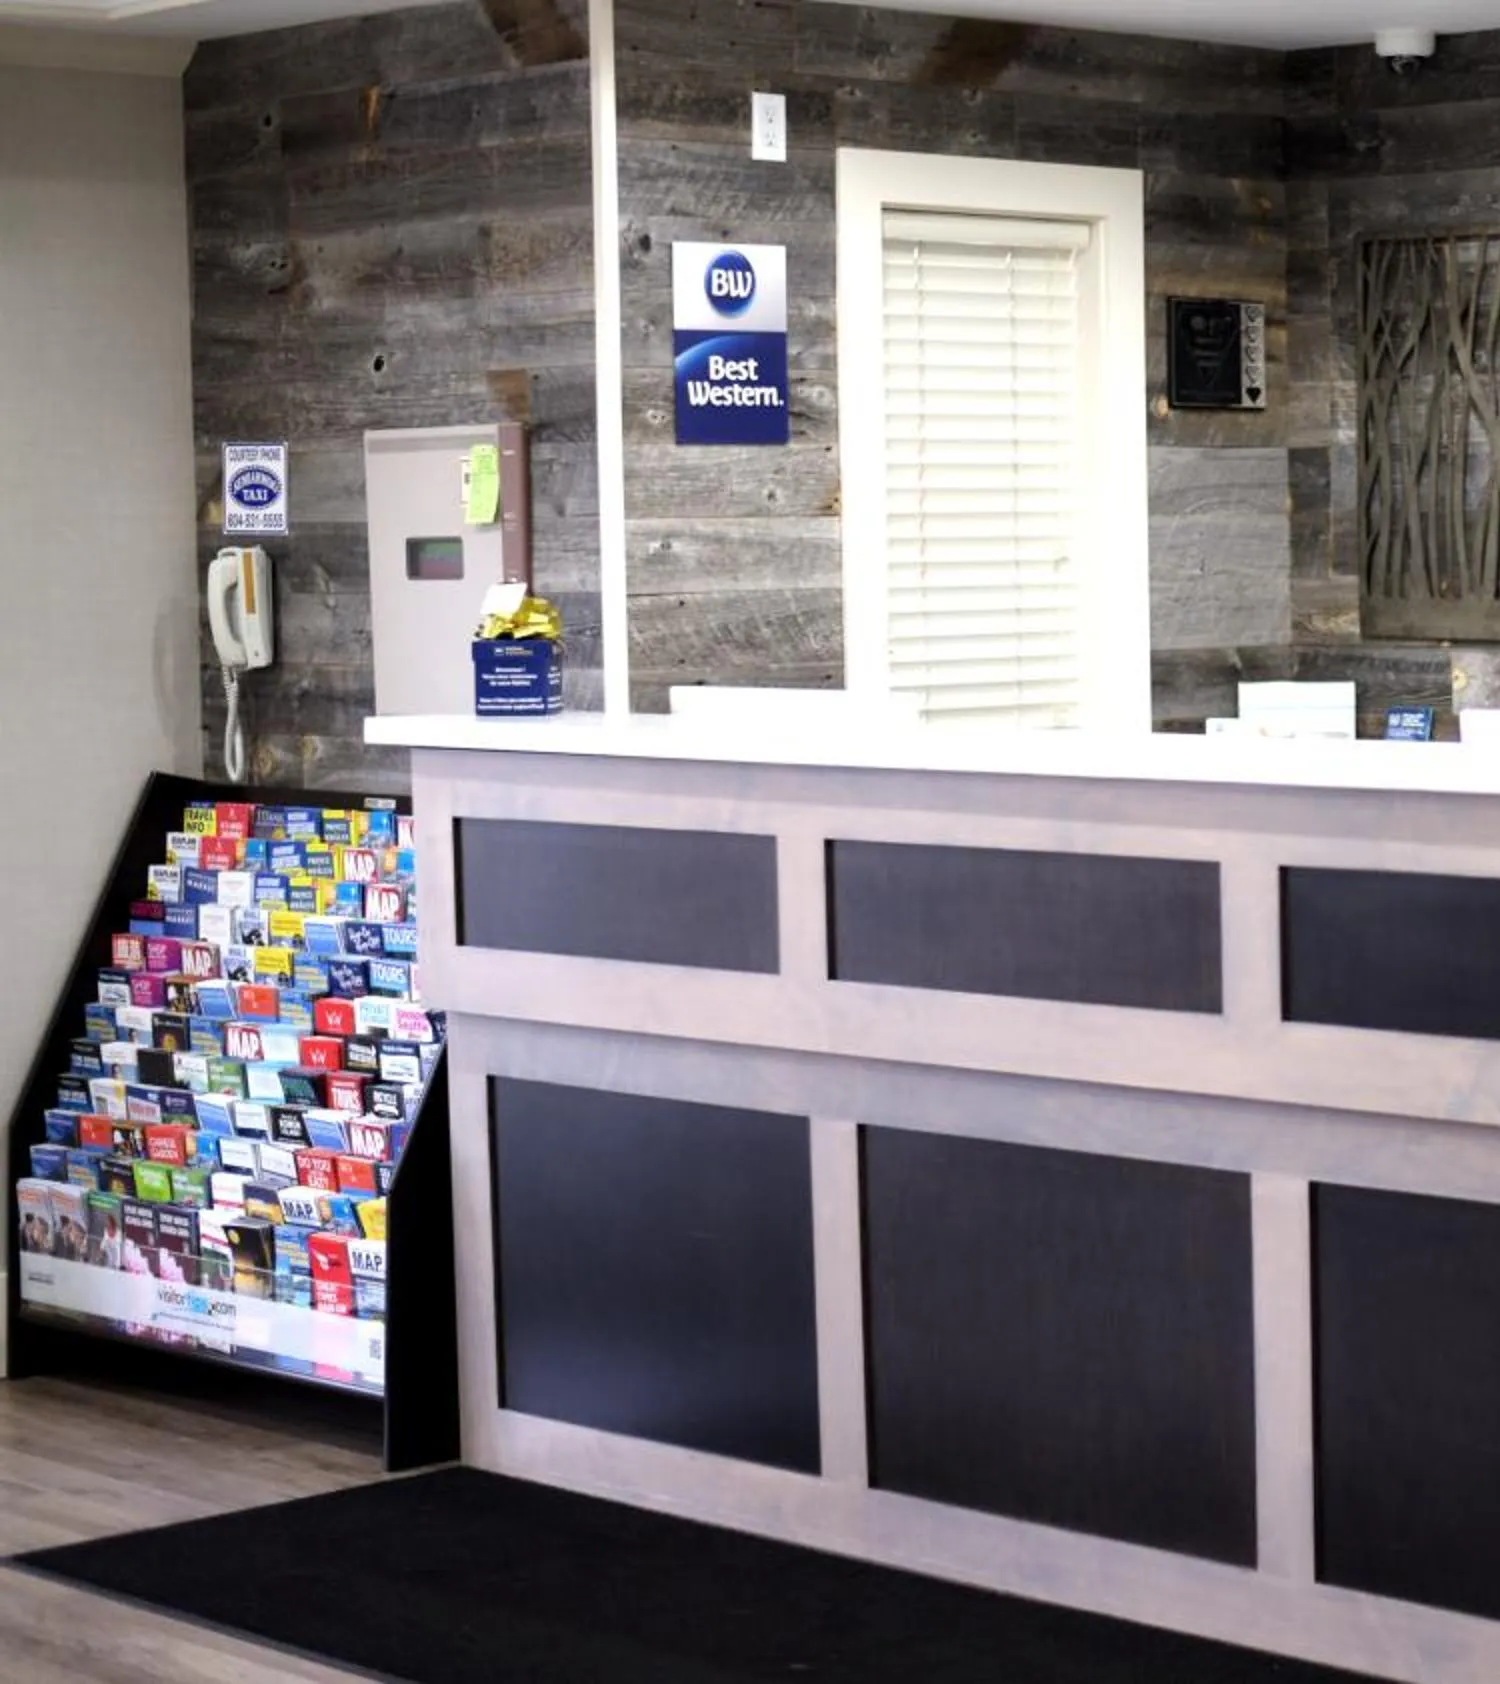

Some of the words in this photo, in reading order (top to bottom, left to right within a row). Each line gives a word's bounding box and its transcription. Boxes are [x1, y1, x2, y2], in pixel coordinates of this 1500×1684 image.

[711, 268, 753, 298] BW
[709, 355, 759, 381] Best
[243, 489, 268, 502] TAXI
[344, 849, 375, 882] MAP
[366, 885, 400, 920] MAP
[182, 945, 212, 978] MAP
[227, 1027, 261, 1060] MAP
[350, 1121, 386, 1160] MAP
[283, 1201, 314, 1220] MAP
[351, 1249, 384, 1272] MAP
